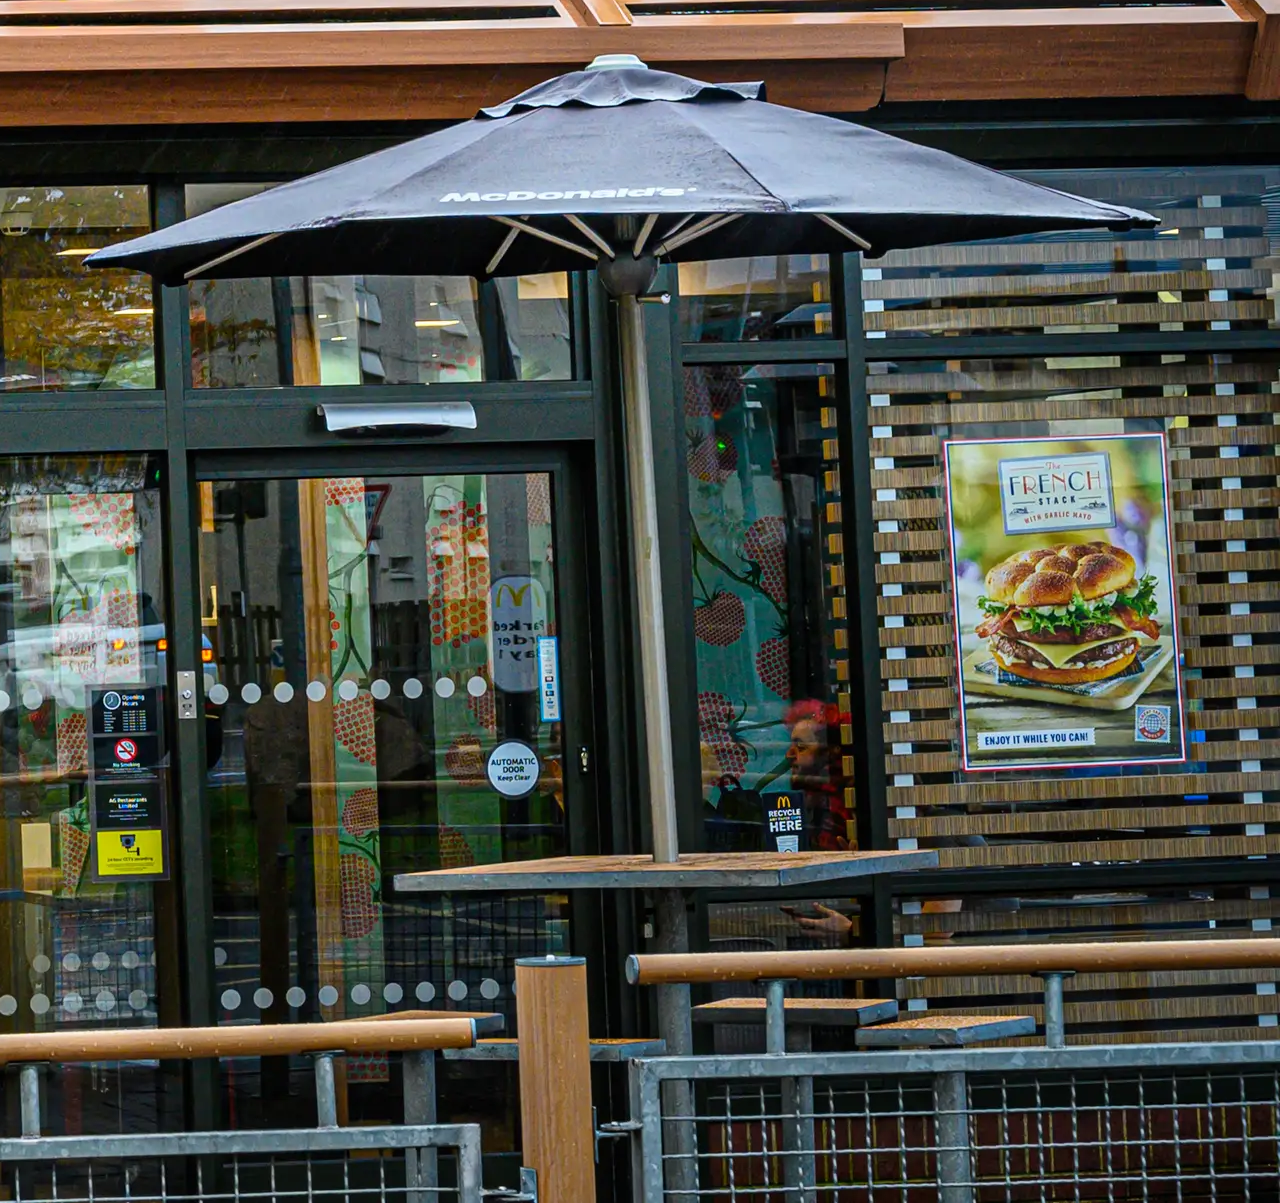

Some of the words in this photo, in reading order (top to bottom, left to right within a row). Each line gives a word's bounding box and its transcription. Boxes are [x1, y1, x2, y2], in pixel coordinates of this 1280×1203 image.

[439, 187, 686, 203] McDonald's
[1008, 470, 1102, 496] FRENCH
[1038, 495, 1076, 506] STACK
[1024, 516, 1042, 524] WITH
[1045, 511, 1070, 520] GARLIC
[1073, 512, 1092, 521] MAYO
[984, 734, 1011, 746] ENJOY
[1013, 734, 1021, 744] IT
[1023, 733, 1048, 744] WHILE
[1050, 733, 1067, 743] YOU
[1069, 732, 1088, 742] CAN!
[490, 757, 536, 766] AUTOMATIC
[502, 766, 525, 774] DOOR
[768, 809, 801, 817] RECYCLE
[769, 820, 802, 832] HERE
